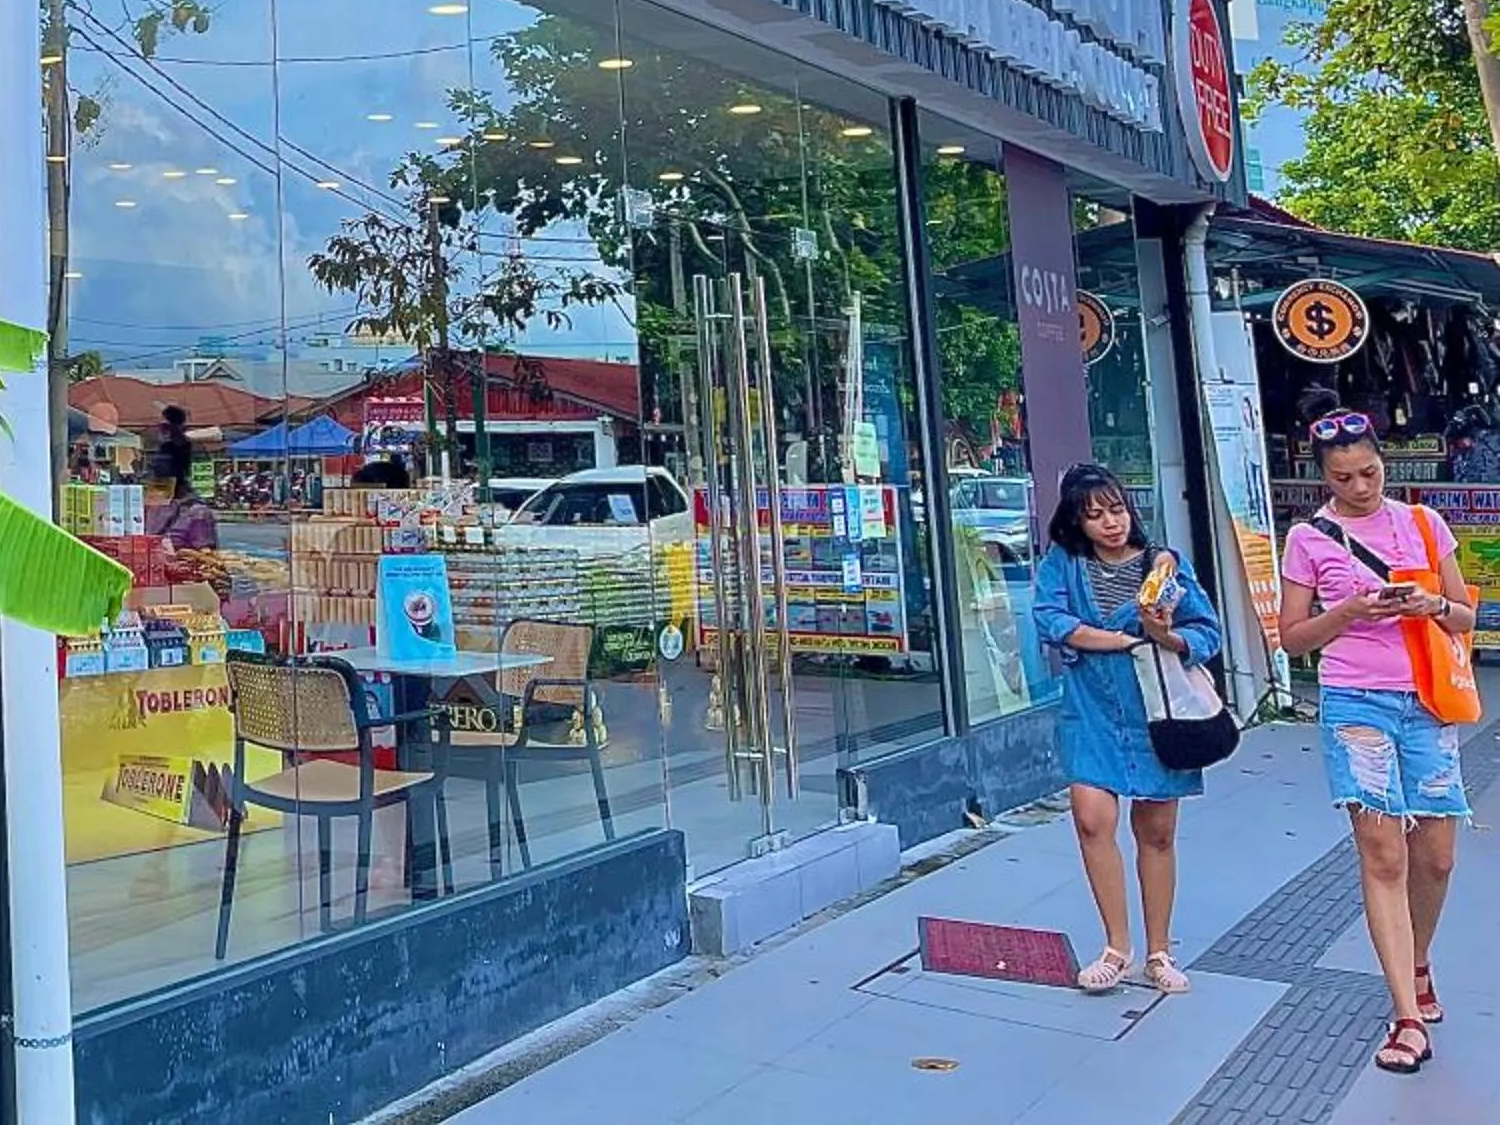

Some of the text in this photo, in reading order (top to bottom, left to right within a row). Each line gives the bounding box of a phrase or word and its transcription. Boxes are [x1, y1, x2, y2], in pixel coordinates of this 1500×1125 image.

[1191, 22, 1224, 83] DUTY
[1196, 77, 1231, 140] FREE
[1021, 264, 1071, 314] COSTA
[136, 686, 229, 718] TOBLERON
[116, 762, 185, 804] TOBLERONE
